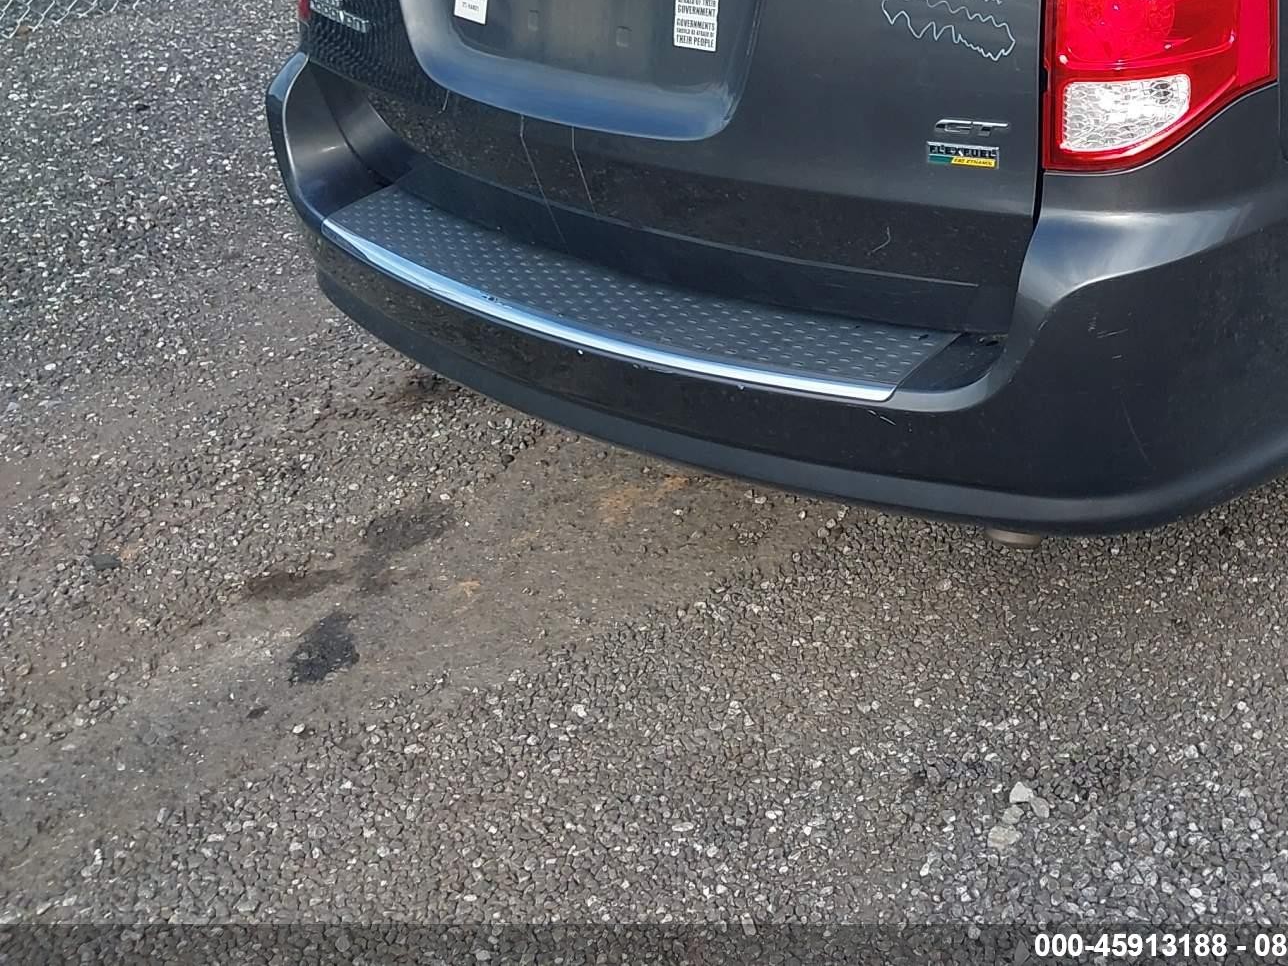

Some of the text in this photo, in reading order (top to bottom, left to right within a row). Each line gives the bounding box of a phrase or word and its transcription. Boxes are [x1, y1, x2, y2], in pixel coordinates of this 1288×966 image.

[677, 4, 716, 17] GOVERNMENT
[676, 18, 715, 31] GOVERNMENTS
[676, 34, 714, 48] THEIR PEOPLE
